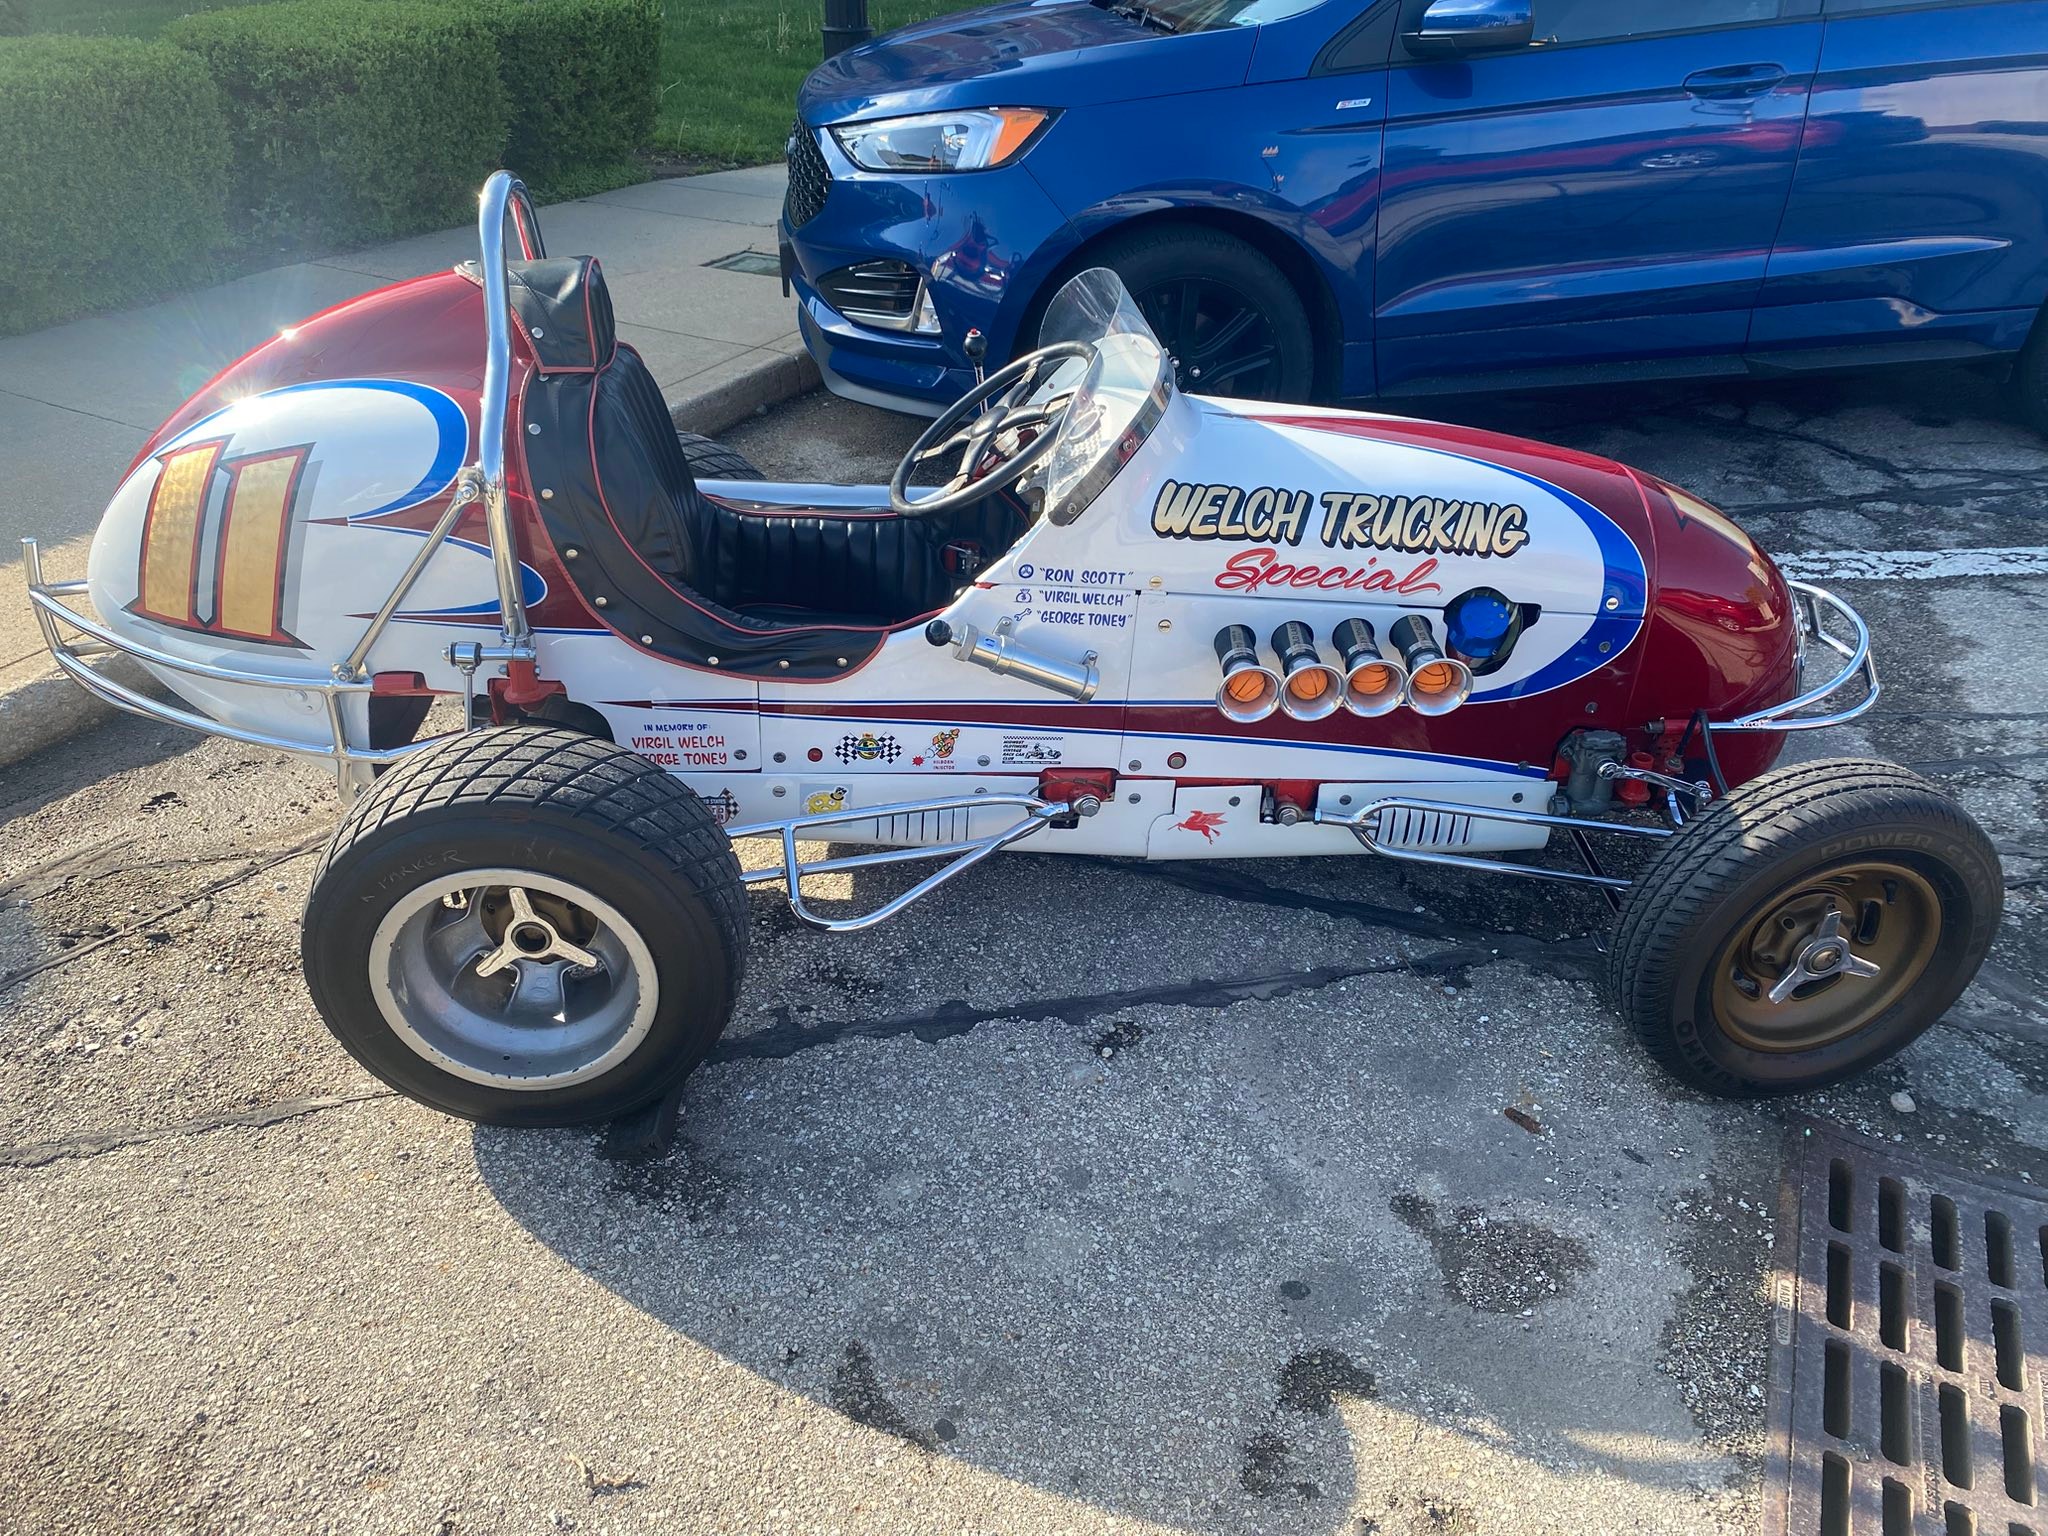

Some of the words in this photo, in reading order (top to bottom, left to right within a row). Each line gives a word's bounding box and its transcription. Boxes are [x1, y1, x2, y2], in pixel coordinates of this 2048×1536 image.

[1151, 479, 1314, 546] WELCH
[1320, 491, 1530, 558] TRUCKING
[120, 433, 317, 650] 11
[1213, 548, 1441, 593] Special
[643, 724, 653, 732] IN
[655, 723, 694, 732] MEMORY
[631, 736, 675, 749] VIRGIL
[678, 735, 725, 748] WELCH
[640, 753, 681, 766] ORGE
[683, 752, 727, 765] TONEY
[1819, 832, 1934, 860] POWER
[1779, 1284, 1791, 1309] MADE
[1777, 1324, 1790, 1341] USA
